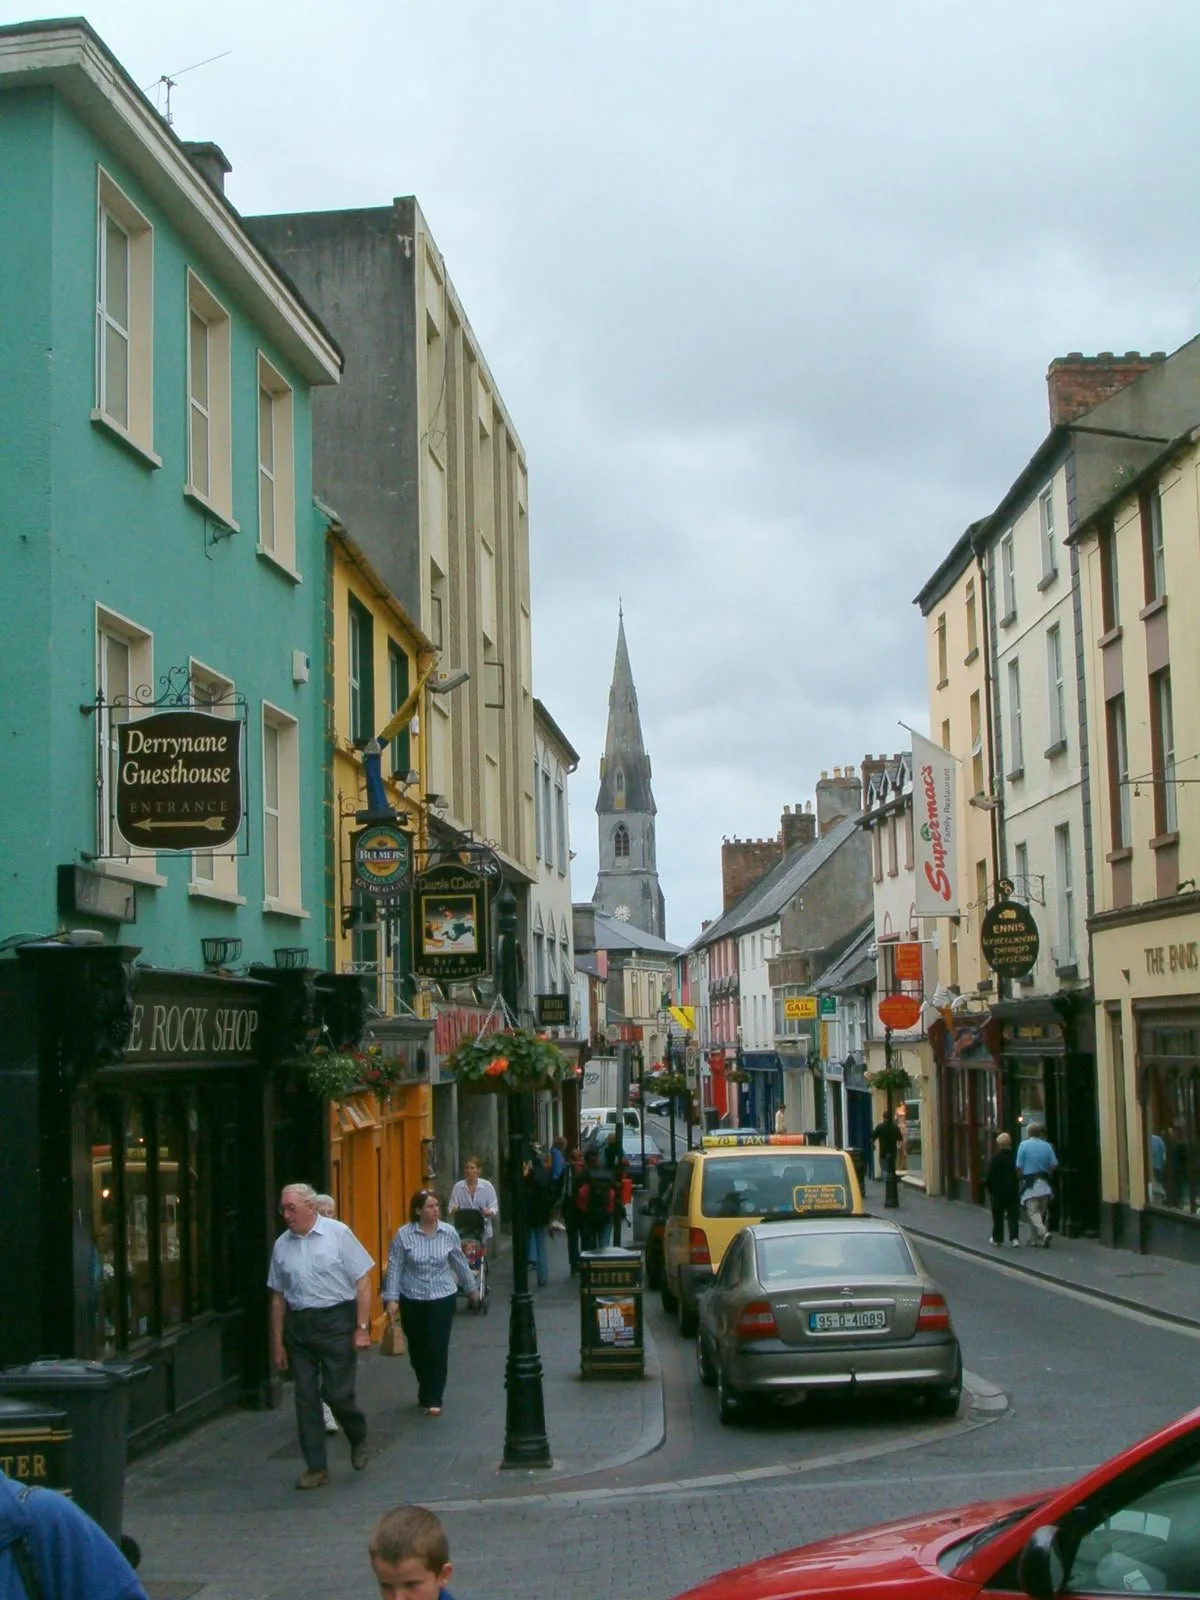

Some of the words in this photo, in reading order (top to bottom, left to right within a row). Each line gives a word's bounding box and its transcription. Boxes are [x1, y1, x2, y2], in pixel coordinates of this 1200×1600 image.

[127, 730, 228, 759] Derrynane
[122, 759, 231, 785] Guesthouse
[129, 800, 228, 814] ENTRANCE
[921, 764, 952, 902] Supermac's
[992, 922, 1026, 934] ENNIS
[1144, 947, 1165, 975] THE
[787, 1003, 812, 1011] GAIL
[150, 1005, 209, 1052] ROCK
[212, 1008, 259, 1052] SHOP
[741, 1135, 767, 1146] TAXI
[590, 1272, 632, 1284] LITTER
